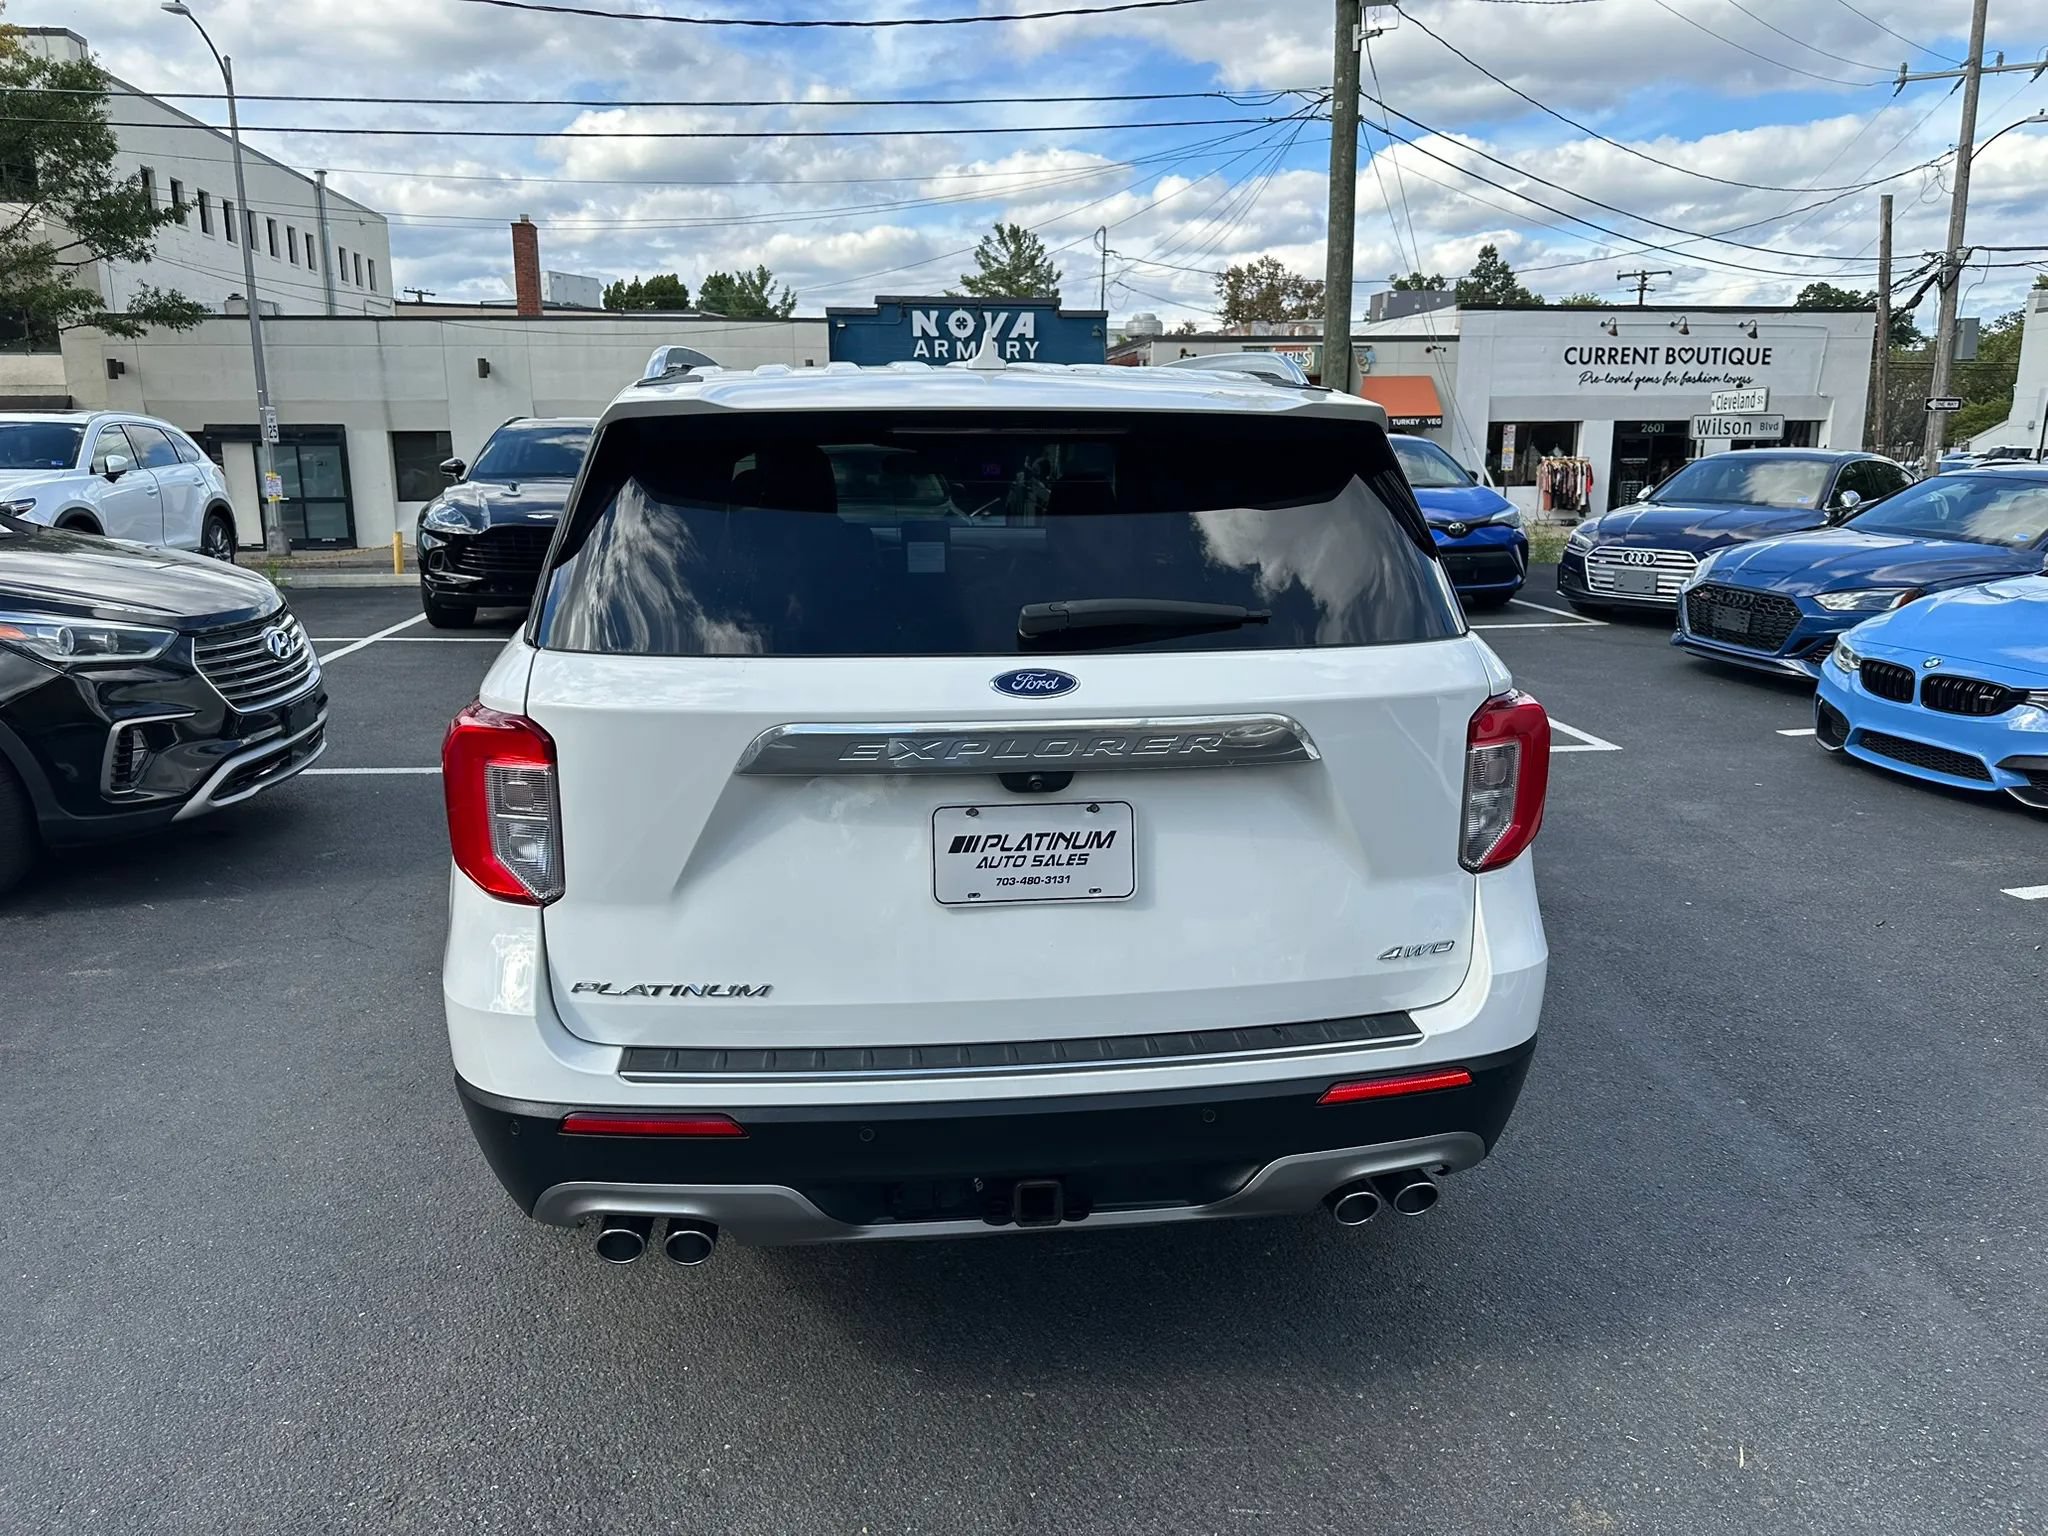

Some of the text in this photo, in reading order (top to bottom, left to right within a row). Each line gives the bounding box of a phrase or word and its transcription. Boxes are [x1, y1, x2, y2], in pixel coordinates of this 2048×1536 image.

[911, 308, 1035, 340] NOVA
[913, 340, 1040, 360] ARMRY
[1564, 346, 1772, 366] CURRENT BOUTIQUE
[1578, 370, 1634, 386] Pre-loved
[1634, 376, 1661, 391] gems
[1661, 370, 1679, 387] for
[1679, 370, 1721, 387] fashion
[1716, 392, 1756, 411] Cleveland
[1392, 418, 1420, 426] TURKEY
[1641, 423, 1665, 433] 2601
[1697, 418, 1780, 435] Wilson Blvd
[268, 424, 278, 439] 25
[1011, 672, 1059, 690] Ford
[838, 733, 1224, 761] EXPLORER
[980, 830, 1117, 853] PLATINUM
[976, 853, 1090, 869] AUTO SALES
[995, 875, 1071, 887] 703-480-3131
[1376, 939, 1456, 961] 4WD
[571, 981, 775, 998] PLATINUM
